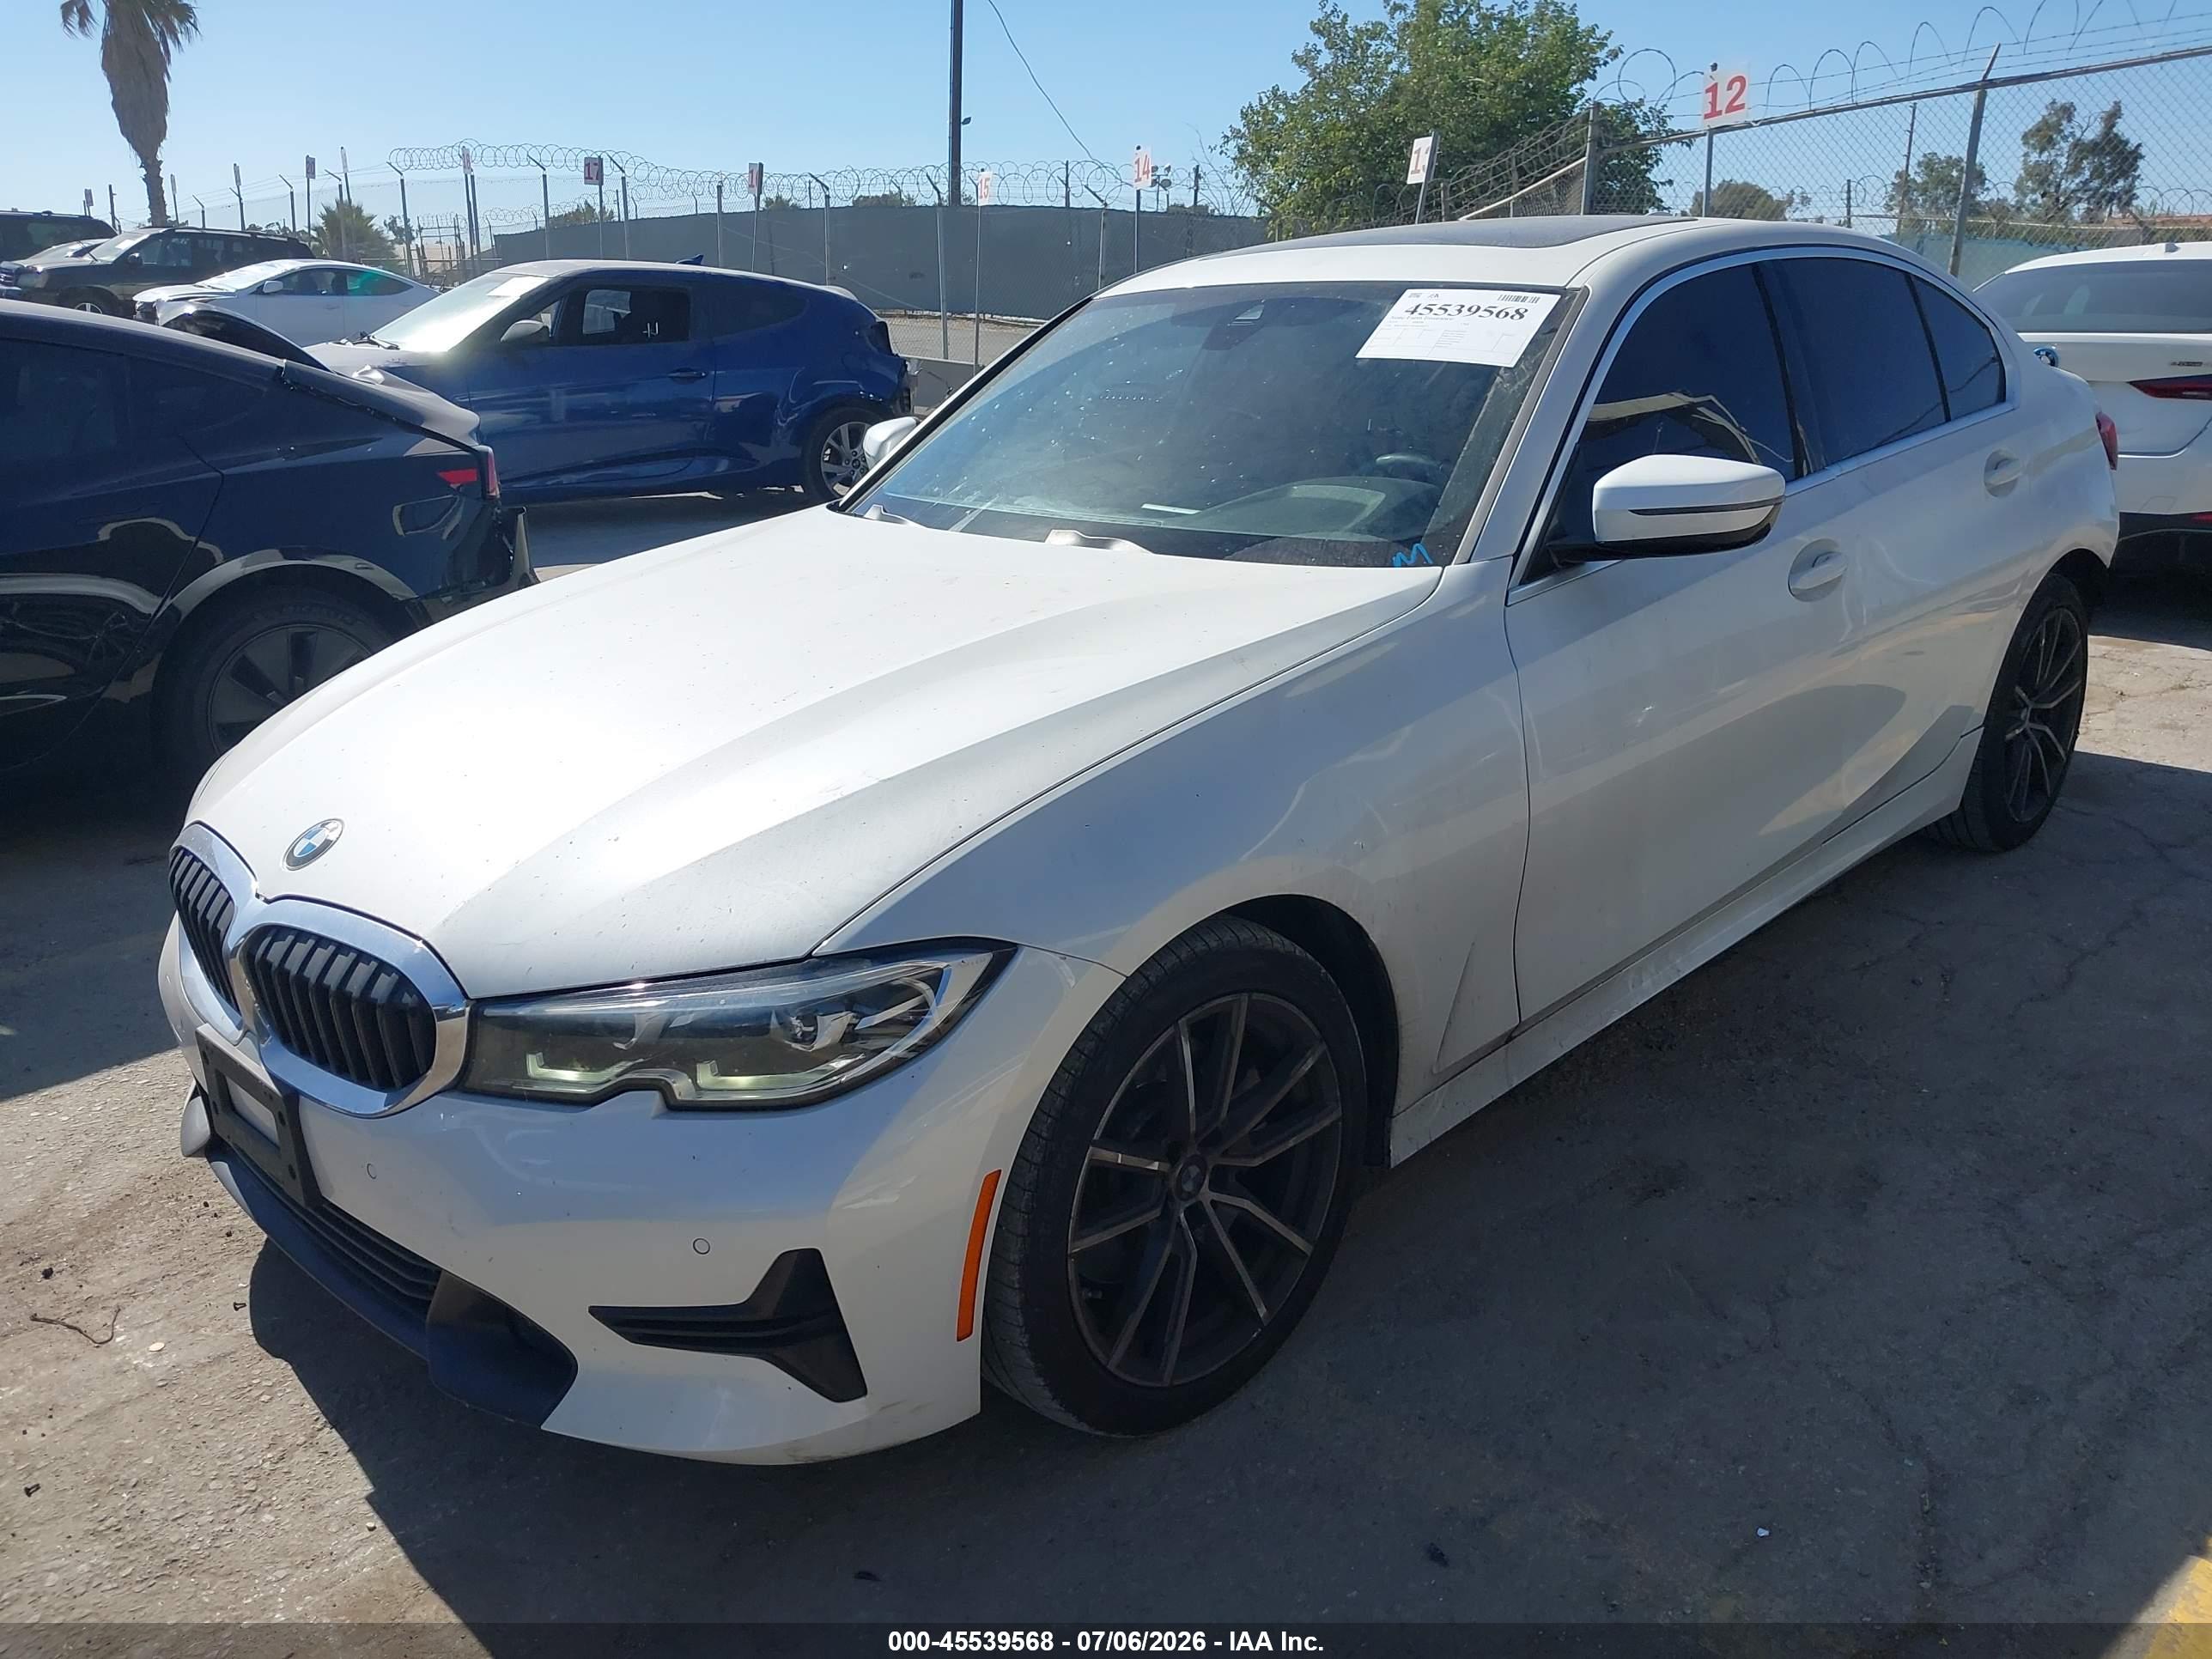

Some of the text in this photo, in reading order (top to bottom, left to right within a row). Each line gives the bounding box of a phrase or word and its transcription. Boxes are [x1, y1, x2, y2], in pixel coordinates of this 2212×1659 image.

[1704, 75, 1747, 119] 12
[1134, 154, 1151, 183] 14
[979, 177, 990, 199] 15
[1404, 302, 1528, 321] 45539568
